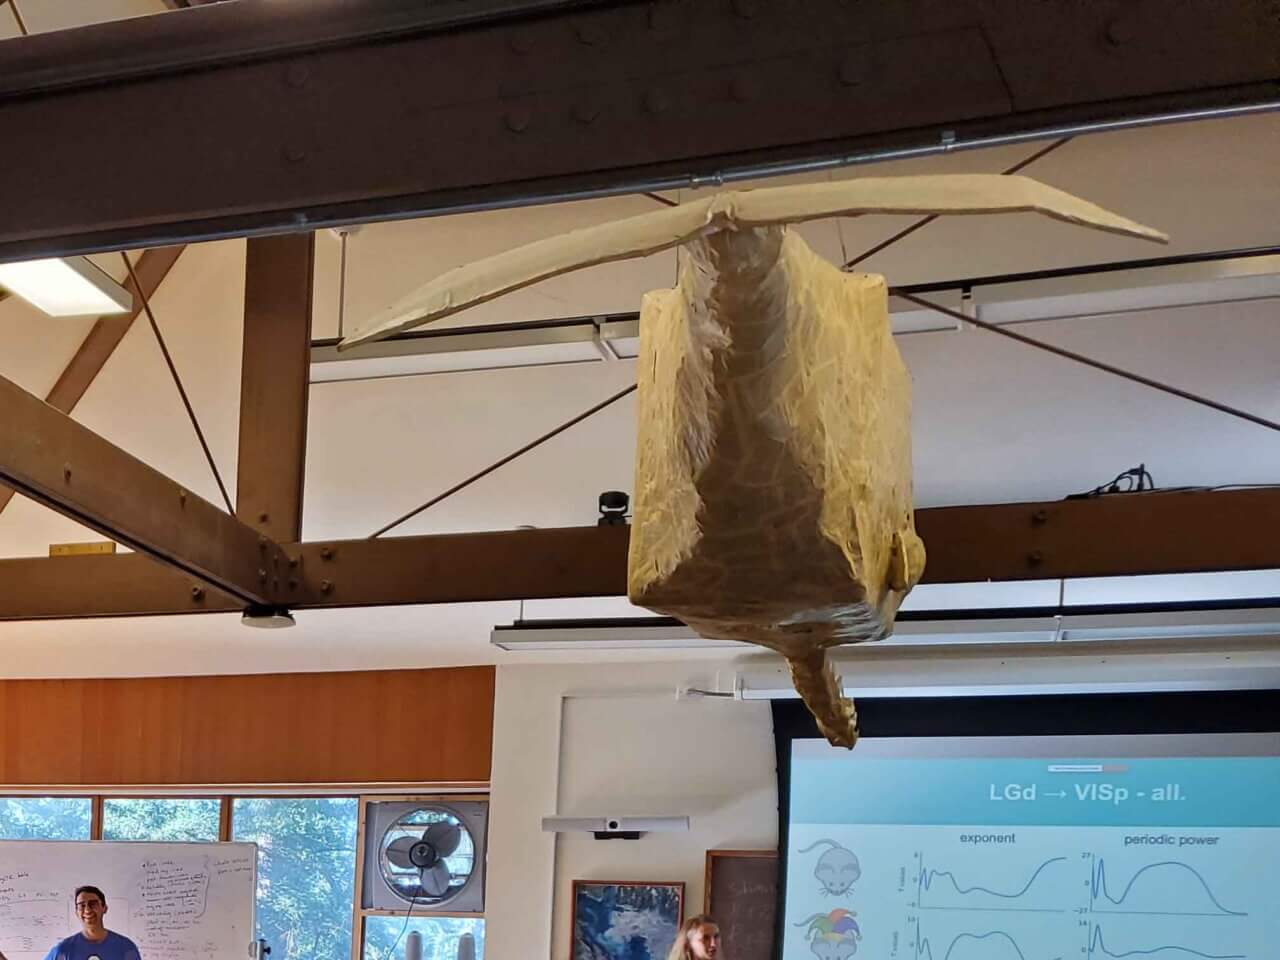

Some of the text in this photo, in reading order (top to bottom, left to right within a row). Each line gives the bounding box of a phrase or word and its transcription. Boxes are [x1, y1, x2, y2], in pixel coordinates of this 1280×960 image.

[989, 783, 1037, 801] LGd
[1074, 783, 1129, 806] VISp
[1151, 783, 1186, 801] all.
[959, 833, 1016, 845] exponent
[1124, 834, 1220, 848] periodic power
